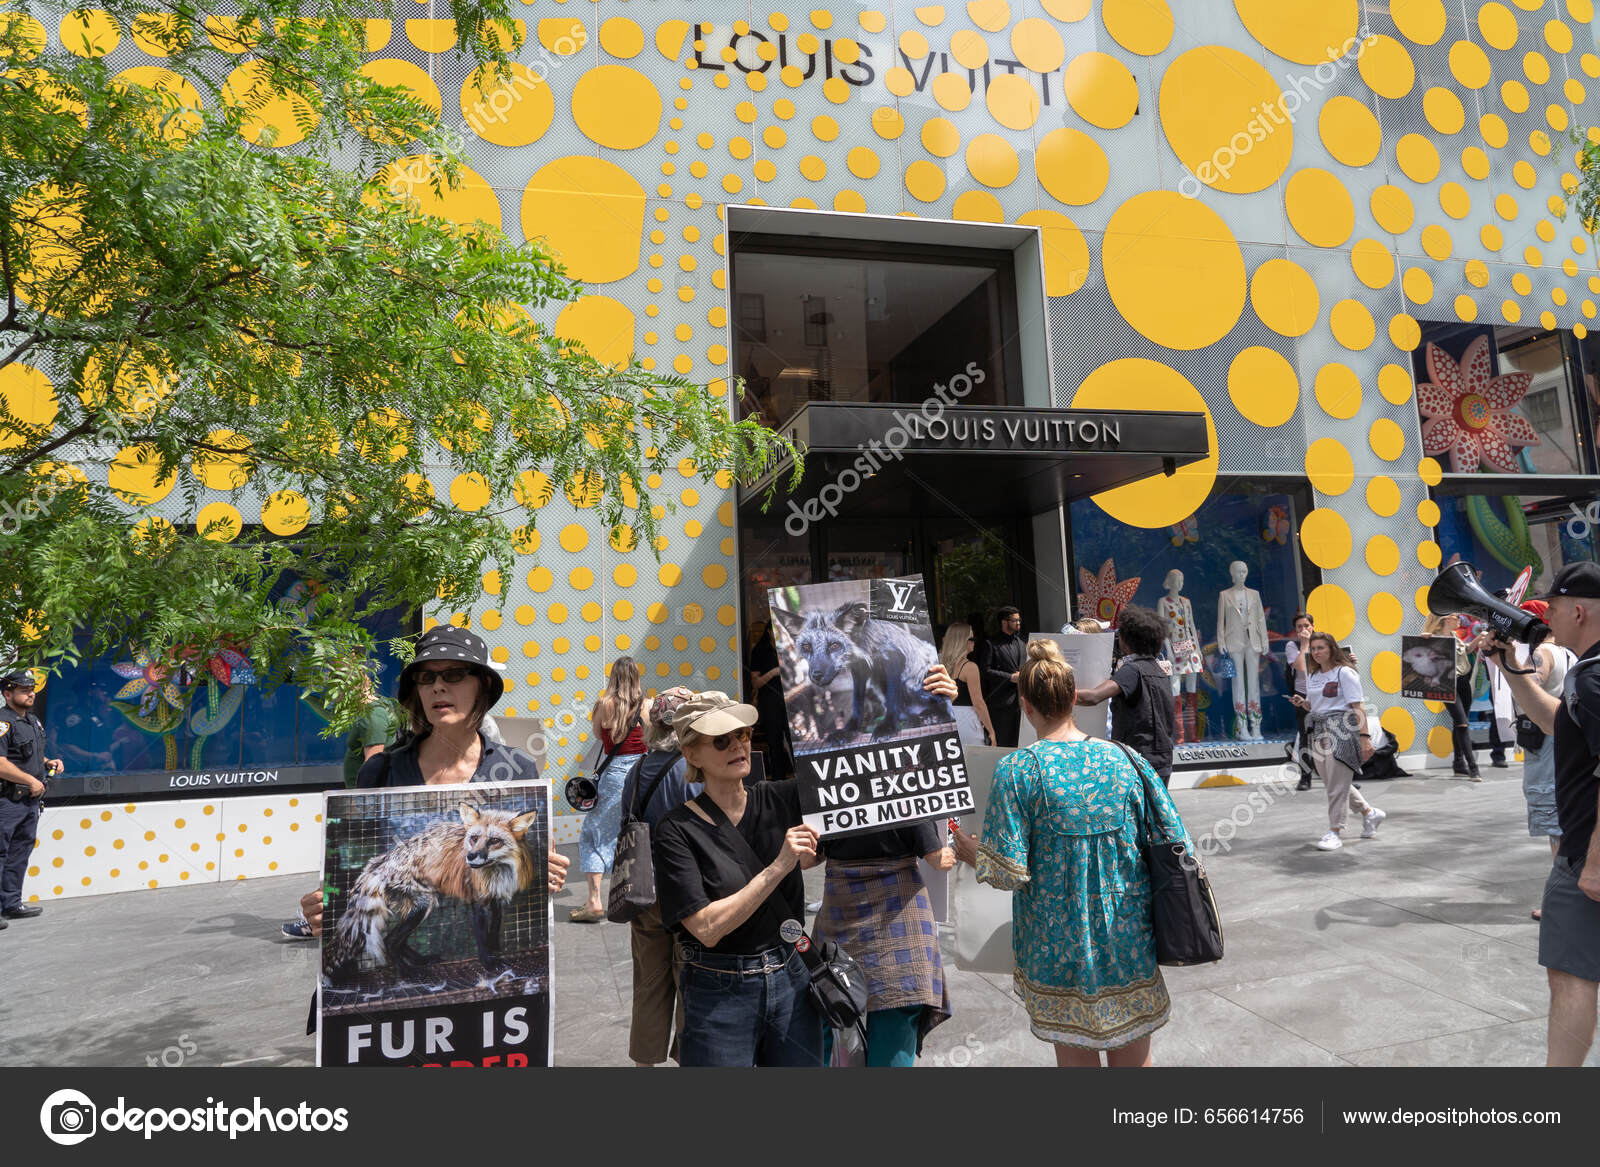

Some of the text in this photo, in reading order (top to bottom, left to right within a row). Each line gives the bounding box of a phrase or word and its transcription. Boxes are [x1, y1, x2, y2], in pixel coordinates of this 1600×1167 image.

[694, 24, 875, 86] LOUIS
[914, 417, 1121, 444] LOUIS VUITTON
[1403, 689, 1424, 698] FUR
[810, 737, 961, 781] VANITY IS
[1177, 747, 1249, 761] LOUIS VUITTON
[169, 770, 278, 787] LOUIS VUITTON
[817, 763, 967, 807] NO EXCUSE
[822, 789, 972, 832] FOR MURDER
[347, 1006, 529, 1064] FUR IS
